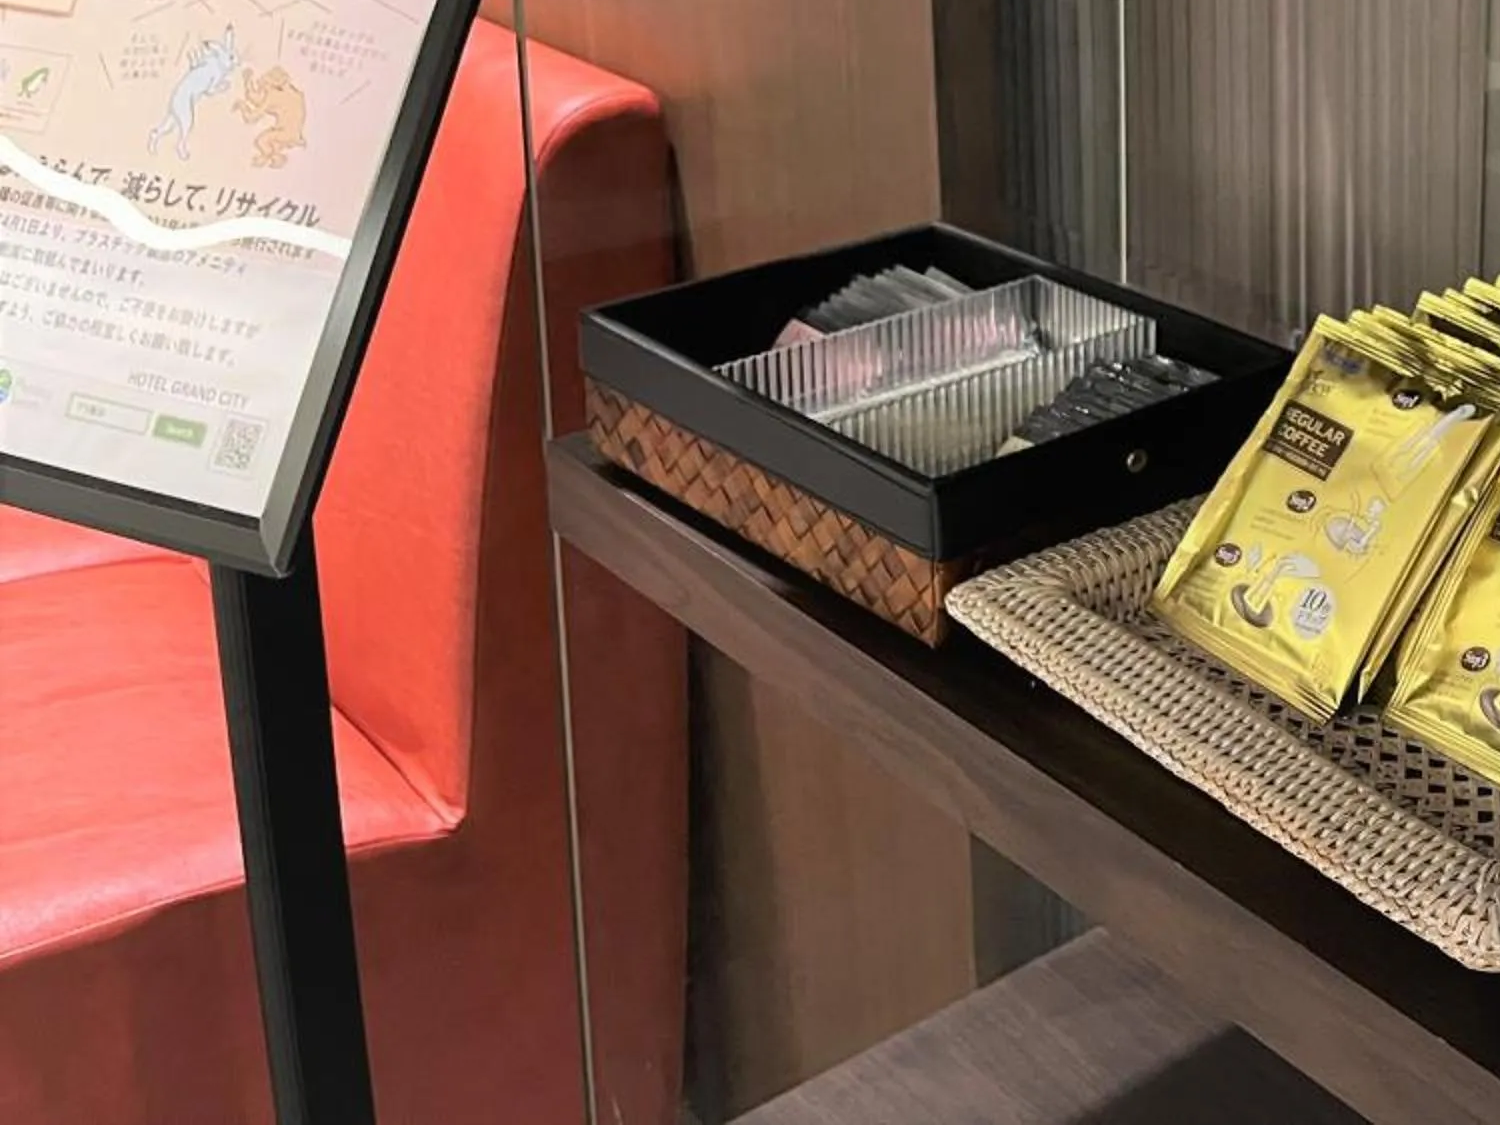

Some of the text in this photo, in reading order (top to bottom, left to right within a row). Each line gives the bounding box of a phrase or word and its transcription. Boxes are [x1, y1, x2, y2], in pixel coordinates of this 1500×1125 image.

[127, 370, 251, 410] HOTEL GRAND CITY
